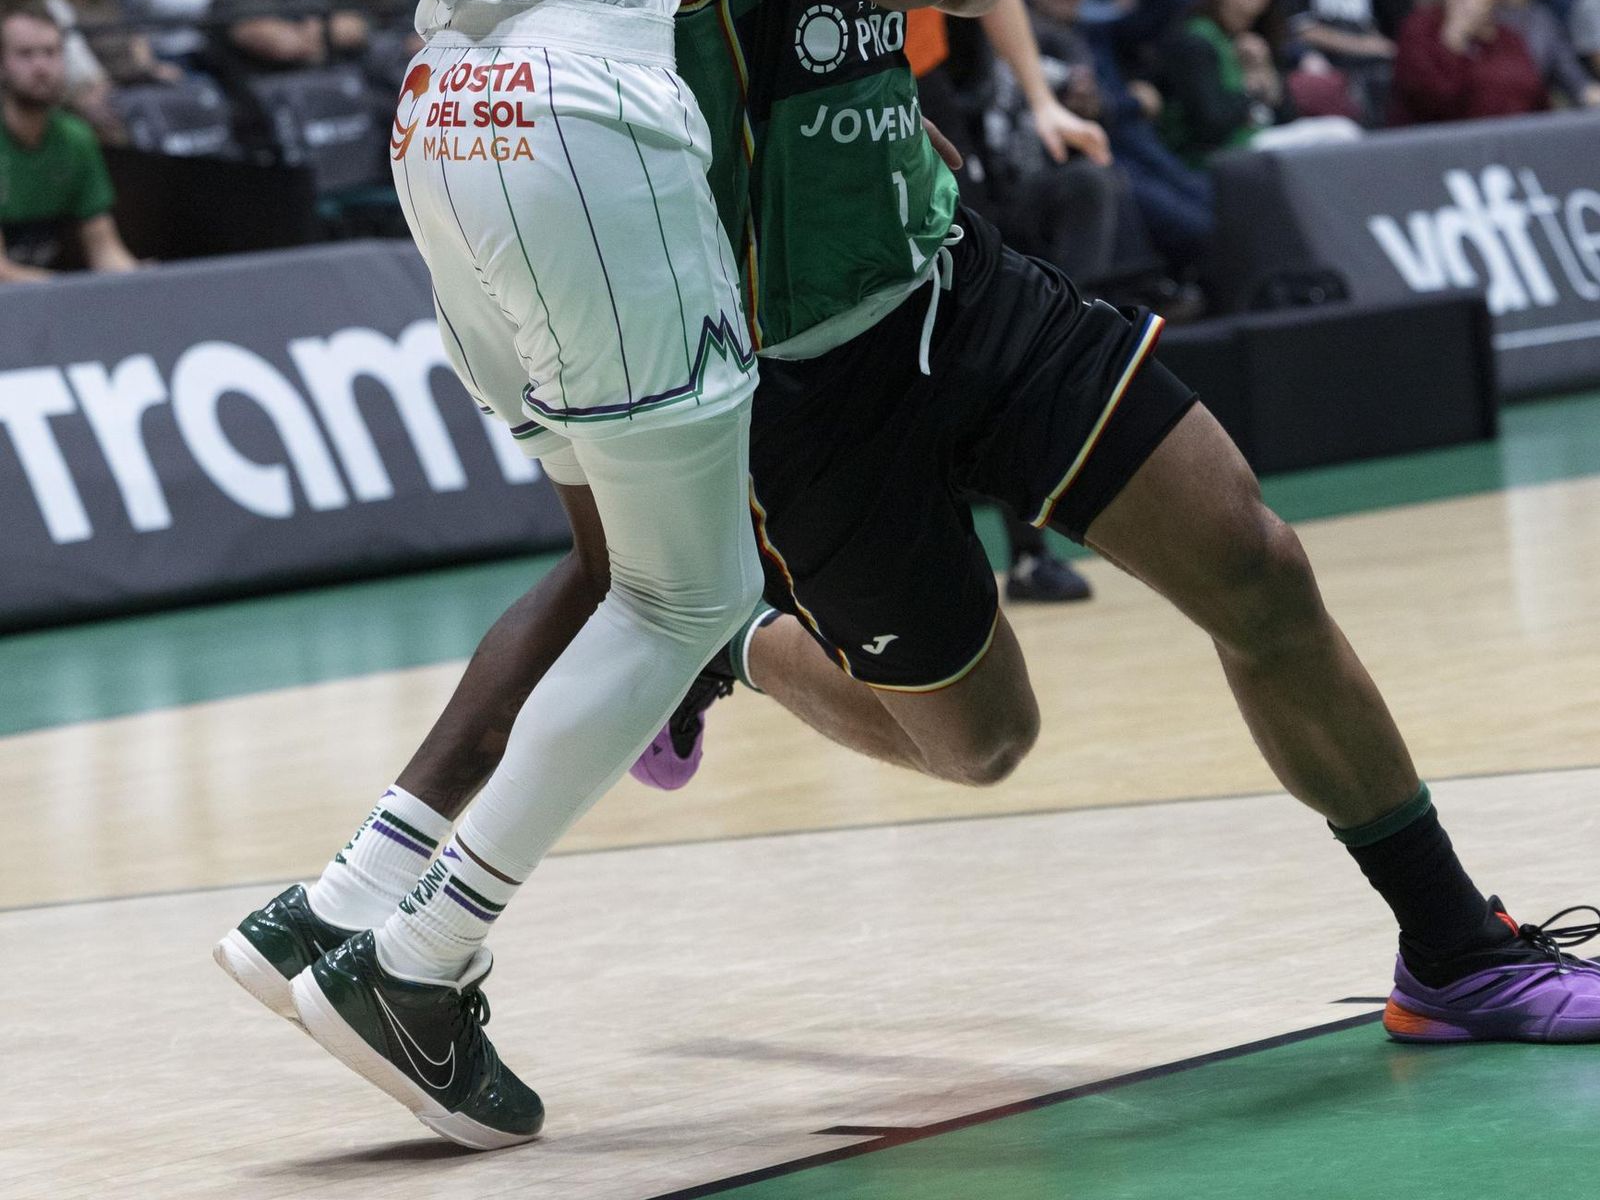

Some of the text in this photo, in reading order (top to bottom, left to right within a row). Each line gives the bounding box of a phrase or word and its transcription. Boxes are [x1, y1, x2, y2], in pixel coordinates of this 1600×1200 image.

[855, 10, 905, 62] PRO
[438, 62, 536, 94] COSTA
[426, 100, 535, 128] DEL SOL
[800, 95, 923, 144] JOVEN
[423, 130, 536, 161] MÁLAGA
